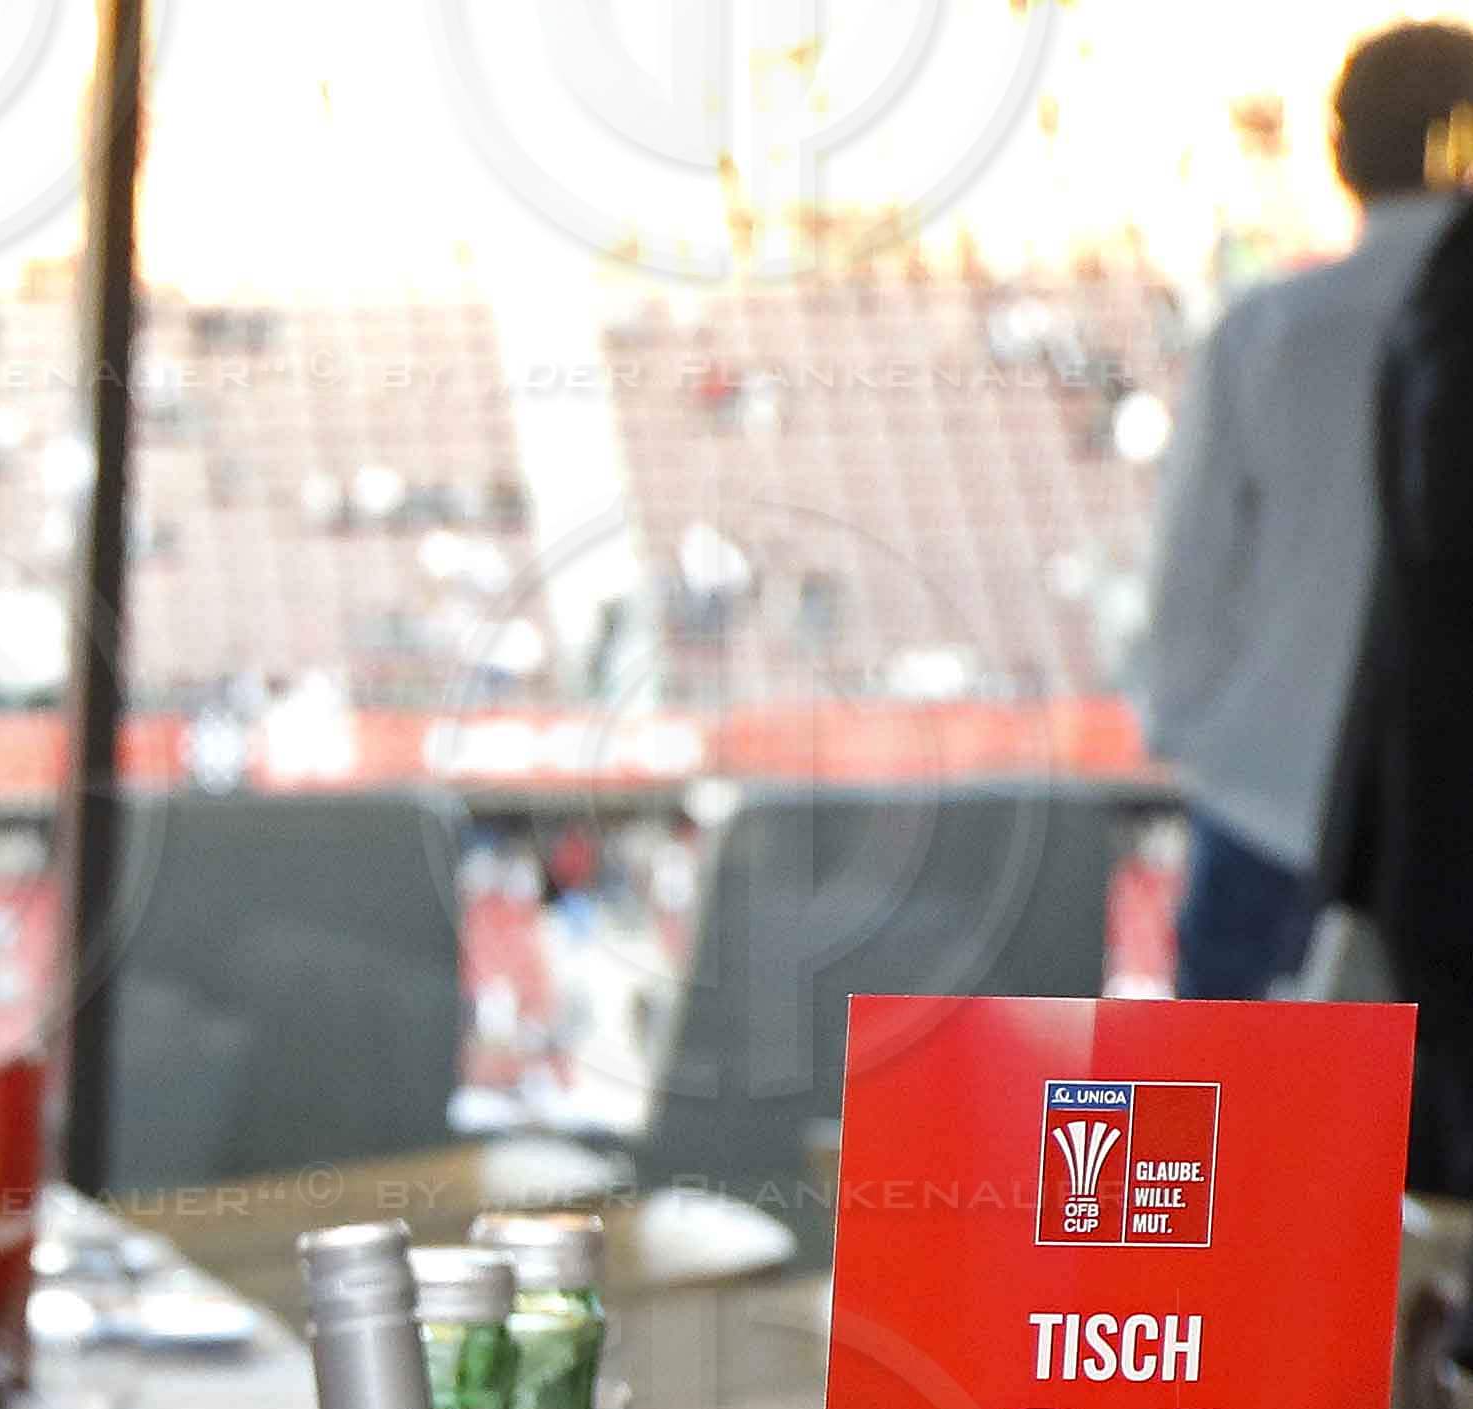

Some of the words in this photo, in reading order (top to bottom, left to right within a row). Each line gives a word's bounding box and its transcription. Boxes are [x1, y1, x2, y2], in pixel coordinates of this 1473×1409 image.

[1077, 1089, 1126, 1104] UNIQA
[1137, 1161, 1204, 1182] GLAUBE.
[1135, 1187, 1186, 1208] WILLE.
[1064, 1219, 1099, 1233] CUP
[1133, 1213, 1173, 1233] MUT.
[1029, 1313, 1203, 1382] TISCH
